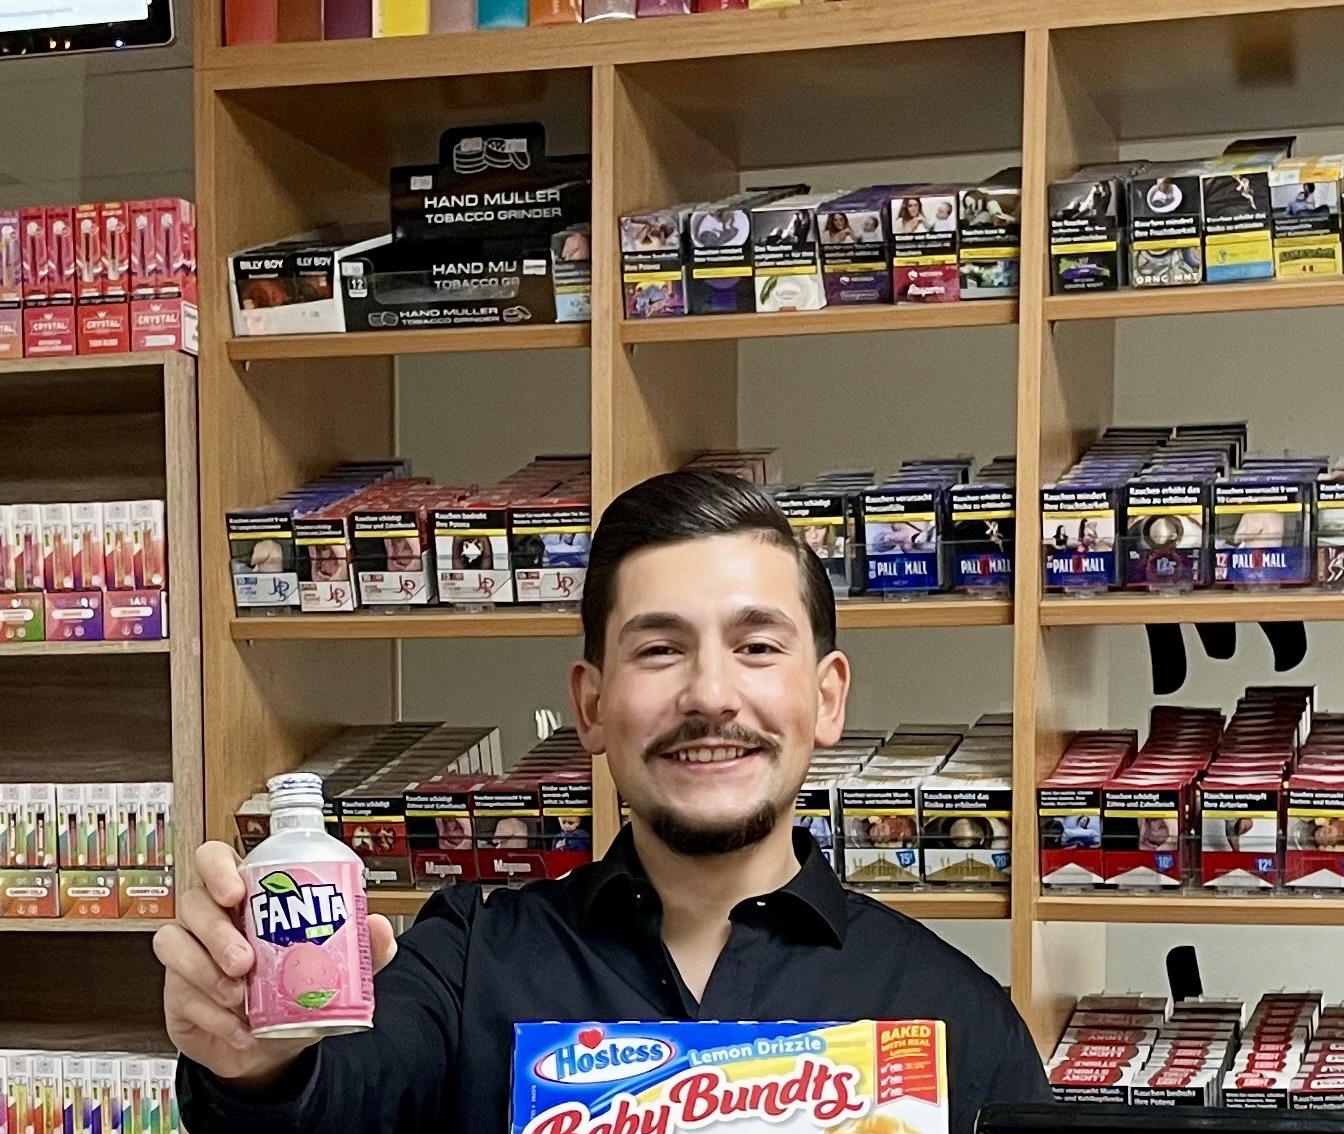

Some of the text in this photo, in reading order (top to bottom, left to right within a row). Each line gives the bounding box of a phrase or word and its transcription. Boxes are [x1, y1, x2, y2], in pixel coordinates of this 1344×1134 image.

[424, 190, 560, 209] HAND MULLER
[425, 207, 562, 224] TOBACCO GRINDER
[433, 262, 483, 276] HAND
[399, 307, 498, 318] HAND MULLER
[877, 561, 928, 576] PALL MALL
[1232, 553, 1286, 569] PALL MALL
[252, 885, 348, 936] FANTA
[880, 1025, 932, 1042] BAKED
[556, 1038, 664, 1080] Hostess
[689, 1036, 823, 1066] Lemon Drizzle
[670, 1061, 863, 1121] Bundts
